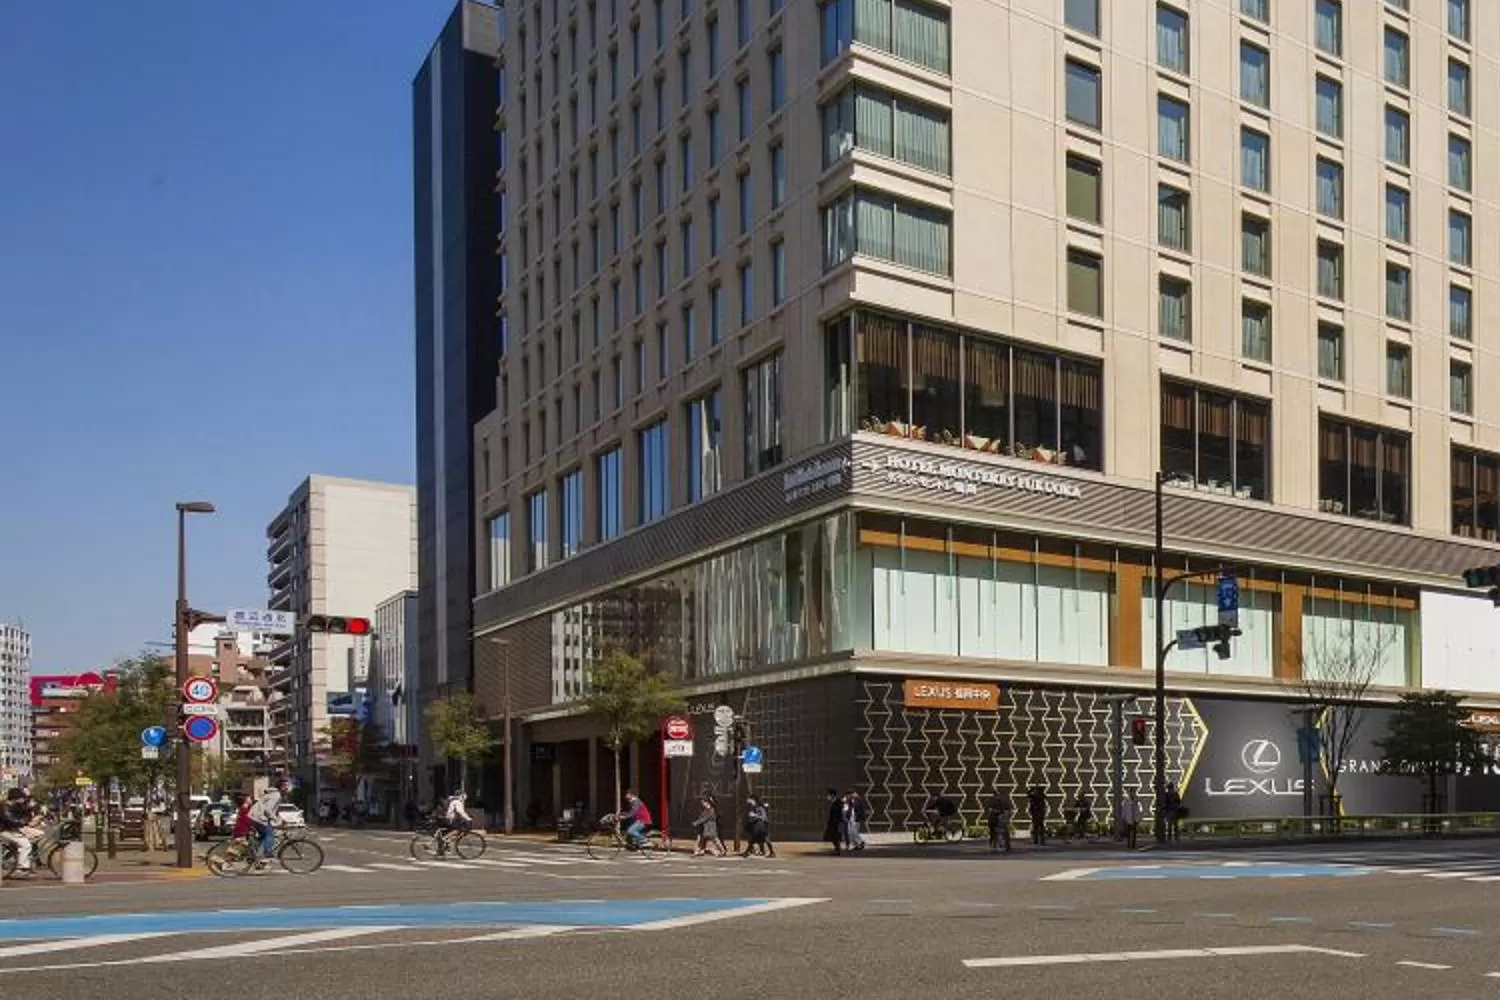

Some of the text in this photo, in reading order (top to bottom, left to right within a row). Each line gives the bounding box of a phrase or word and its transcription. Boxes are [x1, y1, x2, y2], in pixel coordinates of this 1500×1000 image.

[887, 456, 1081, 499] HOTEL MONTEREY FUKUOKA
[914, 686, 951, 698] LEXUS
[1204, 777, 1315, 796] LEXUS
